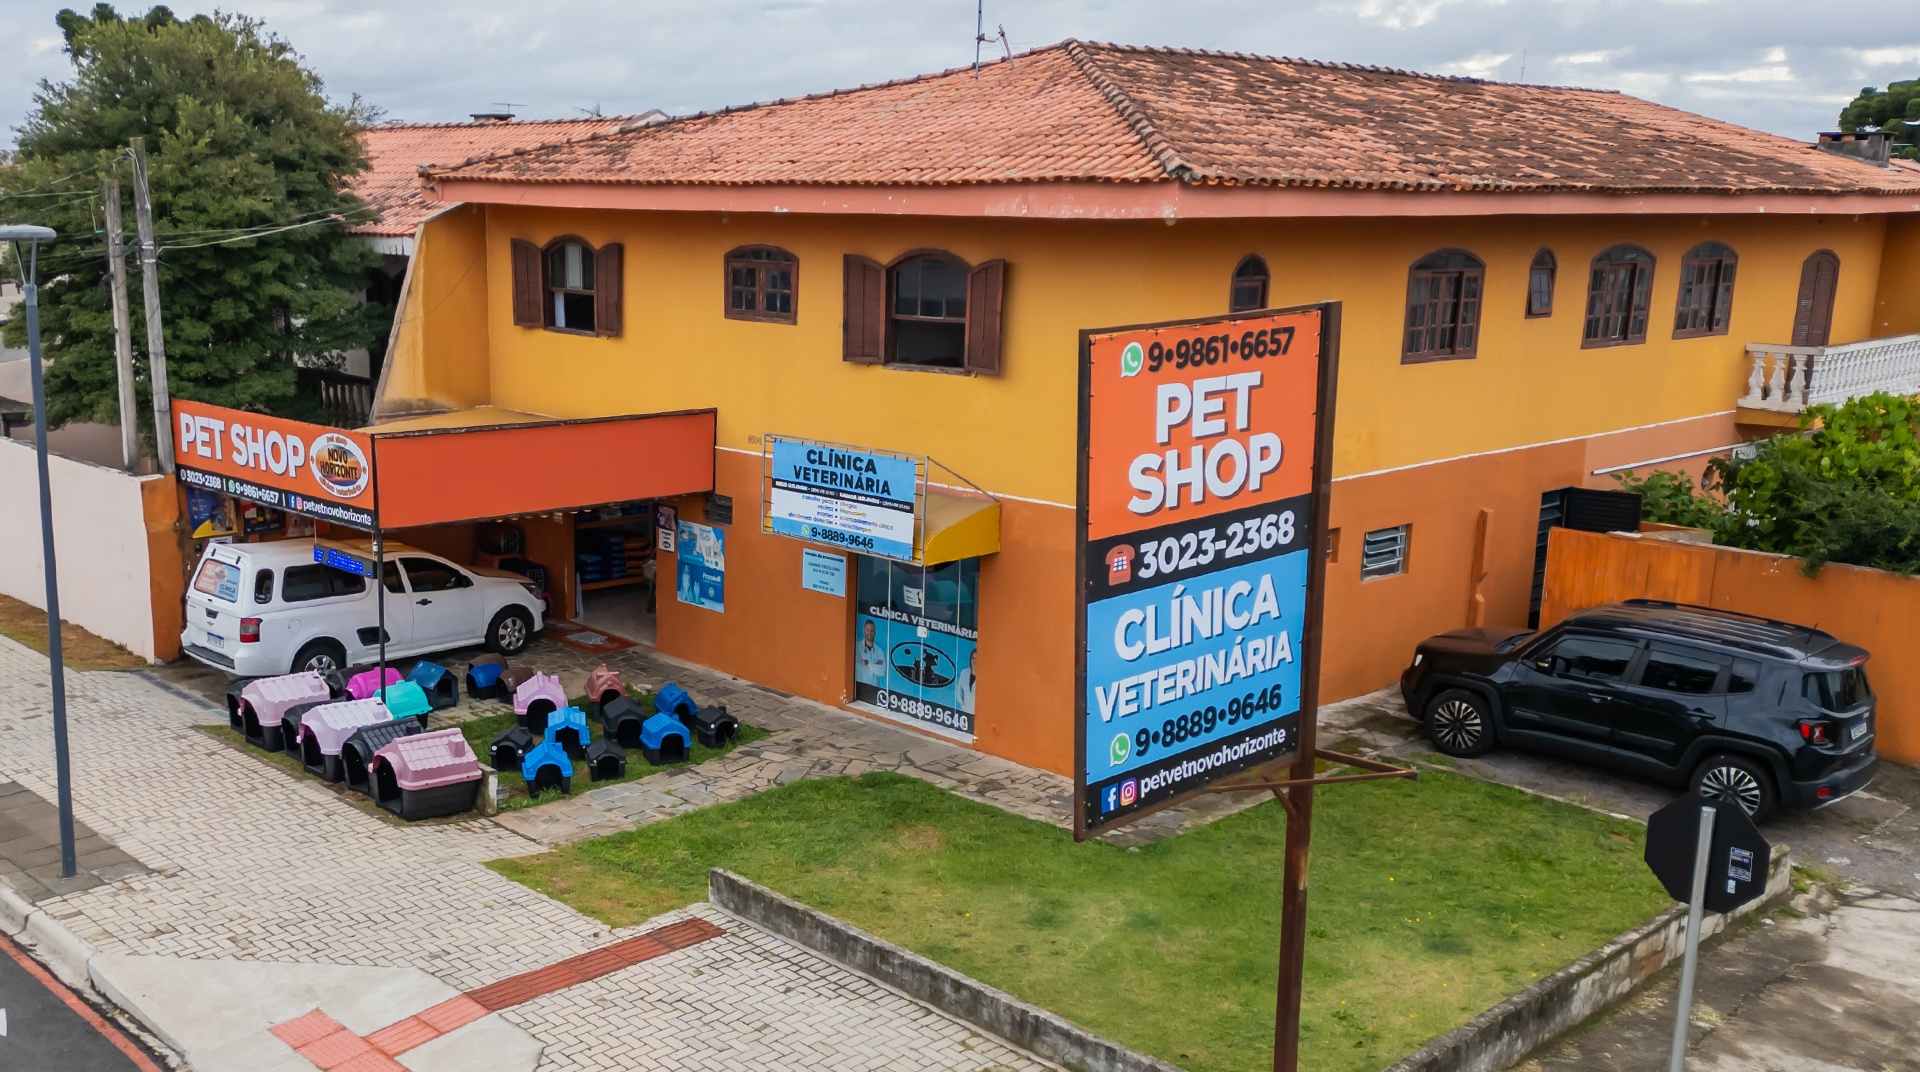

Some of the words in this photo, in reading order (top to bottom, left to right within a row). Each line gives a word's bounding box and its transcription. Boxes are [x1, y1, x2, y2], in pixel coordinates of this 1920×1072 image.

[1156, 371, 1262, 444] PET
[180, 412, 225, 460] PET
[230, 423, 305, 478] SHOP
[319, 461, 358, 480] HORIZONTE
[327, 447, 348, 464] NOVO
[806, 448, 877, 475] CLÍNICA
[1127, 432, 1283, 515] SHOP
[303, 500, 372, 526] petvetnovohorizonte
[793, 465, 892, 496] VETERINÁRIA
[1138, 510, 1295, 579] 3023-2368
[870, 605, 909, 622] CLÍNICA
[911, 615, 978, 639] VETERINÁRIA
[1114, 573, 1281, 661] CLÍNICA
[1095, 630, 1293, 723] VETERINÁRIA
[1140, 728, 1286, 798] petvetnovohorizonte
